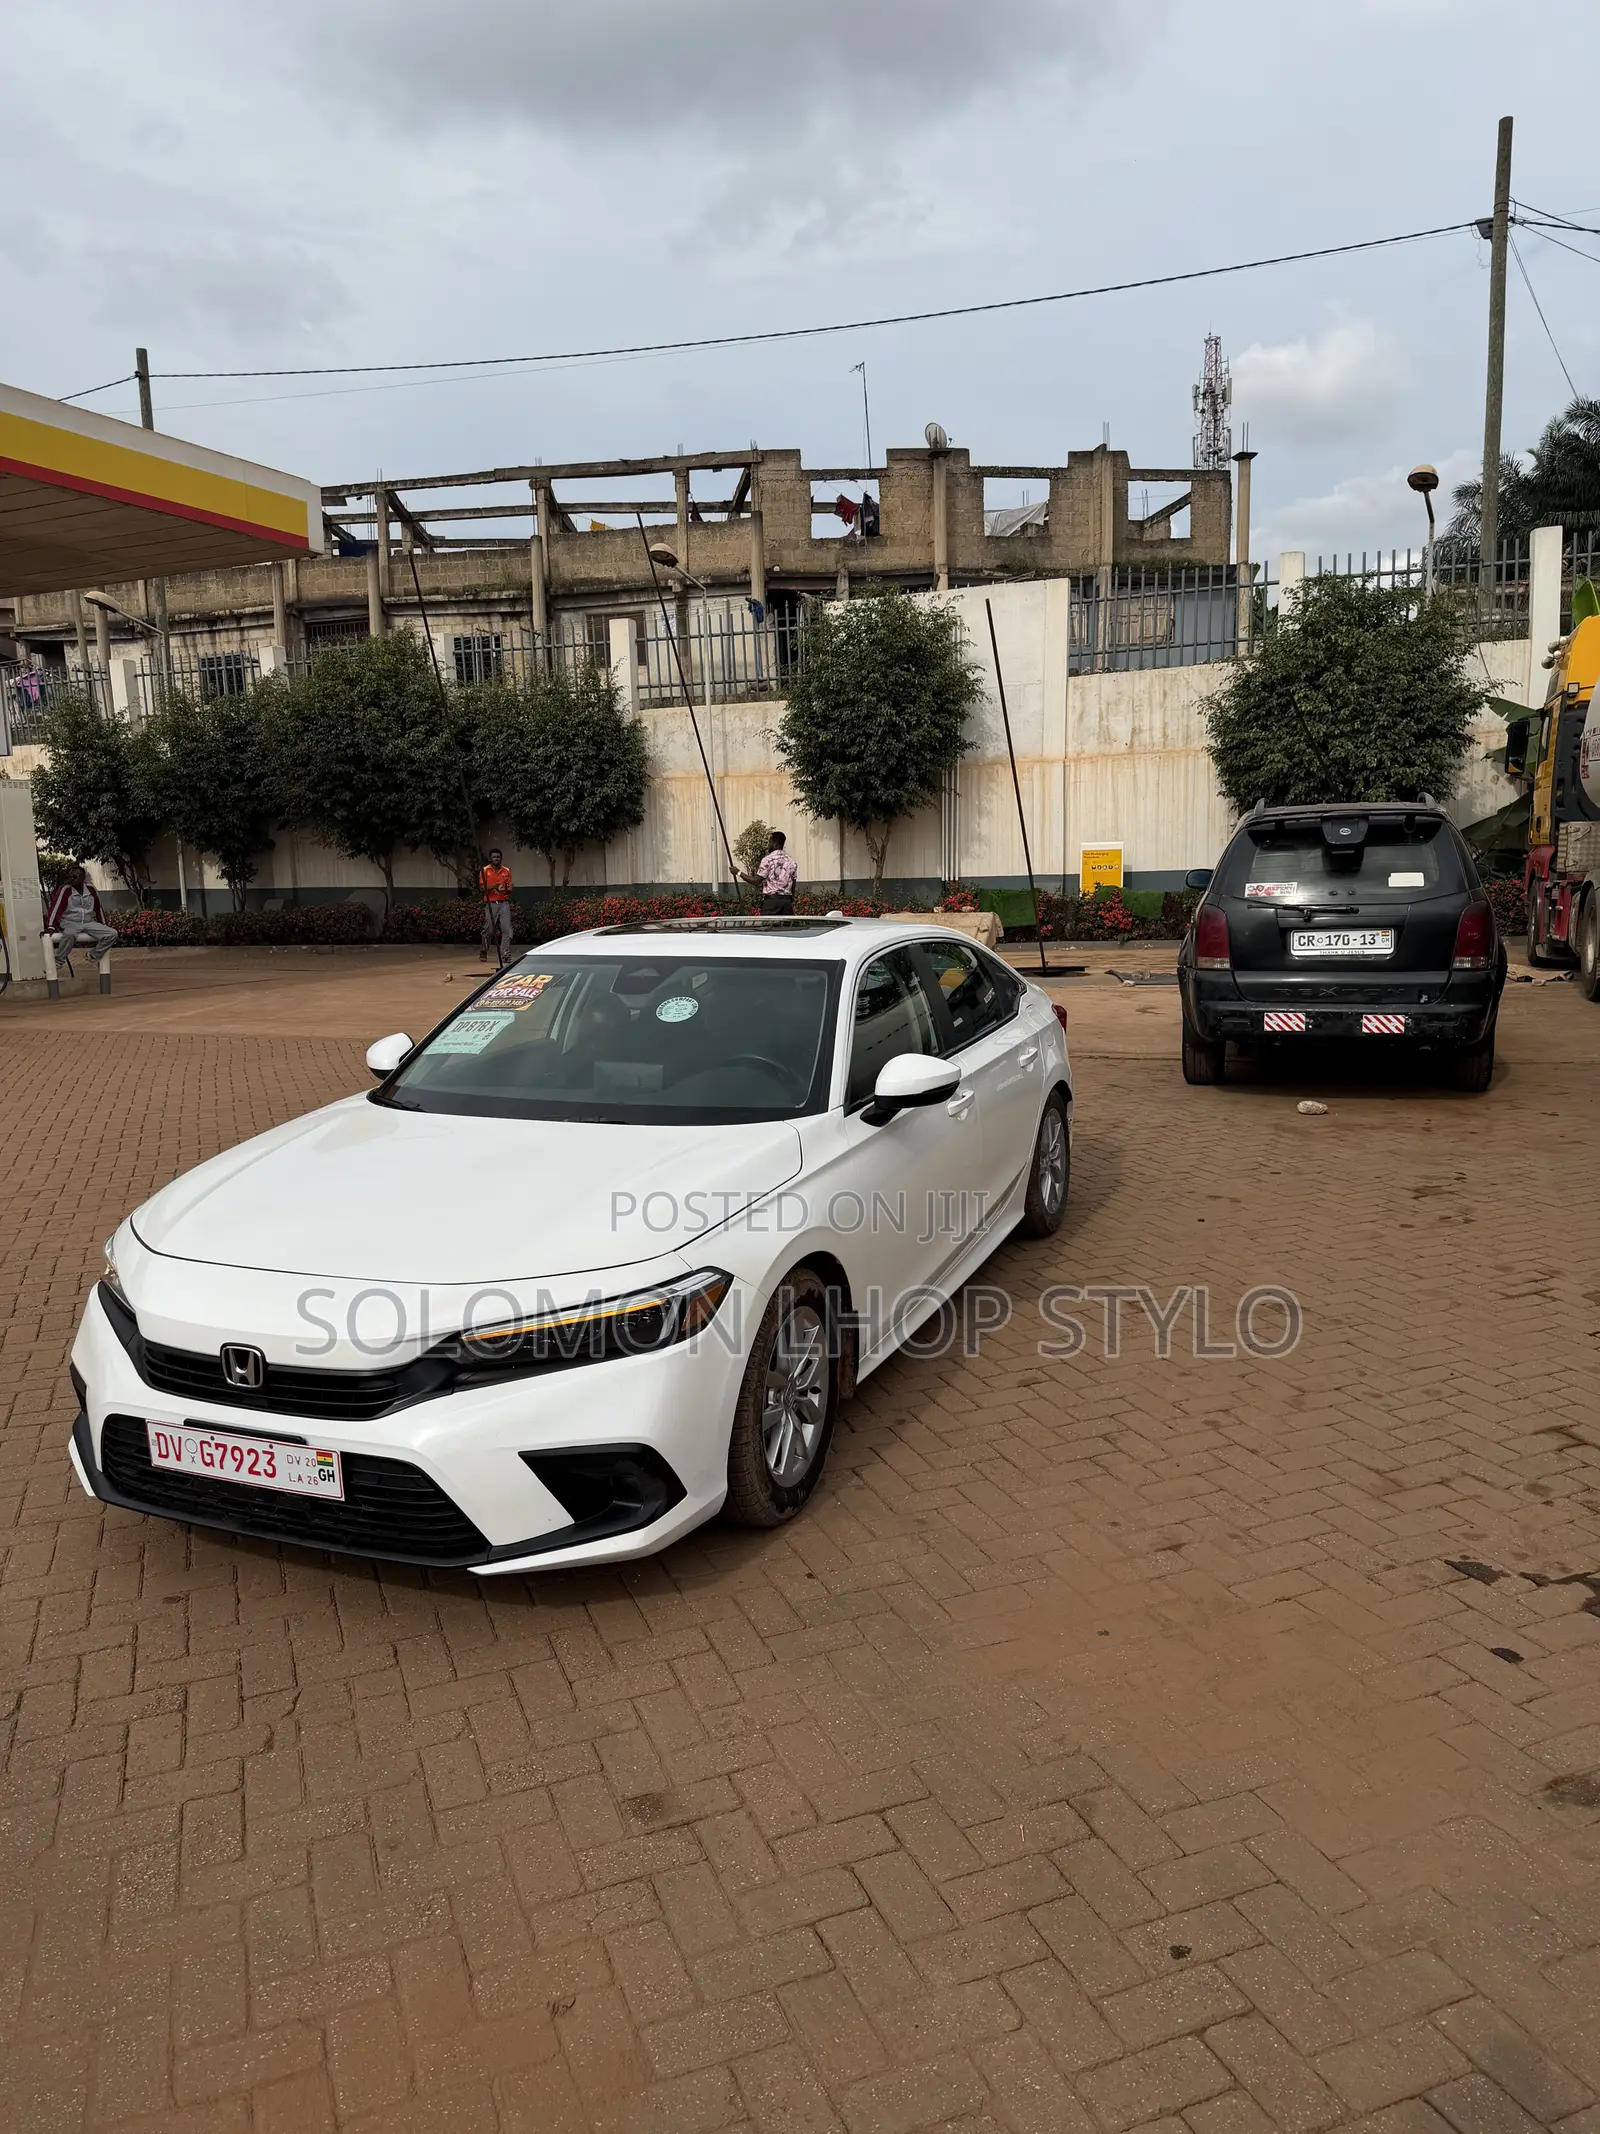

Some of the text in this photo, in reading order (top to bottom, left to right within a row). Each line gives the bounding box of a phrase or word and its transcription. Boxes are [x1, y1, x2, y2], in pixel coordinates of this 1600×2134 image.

[1298, 935, 1315, 946] CR
[495, 974, 554, 989] CAR
[483, 987, 541, 999] FOR SALE
[154, 1431, 277, 1479] DV G7923
[286, 1454, 317, 1467] DV 20
[307, 1475, 319, 1486] 26
[318, 1468, 336, 1483] GH
